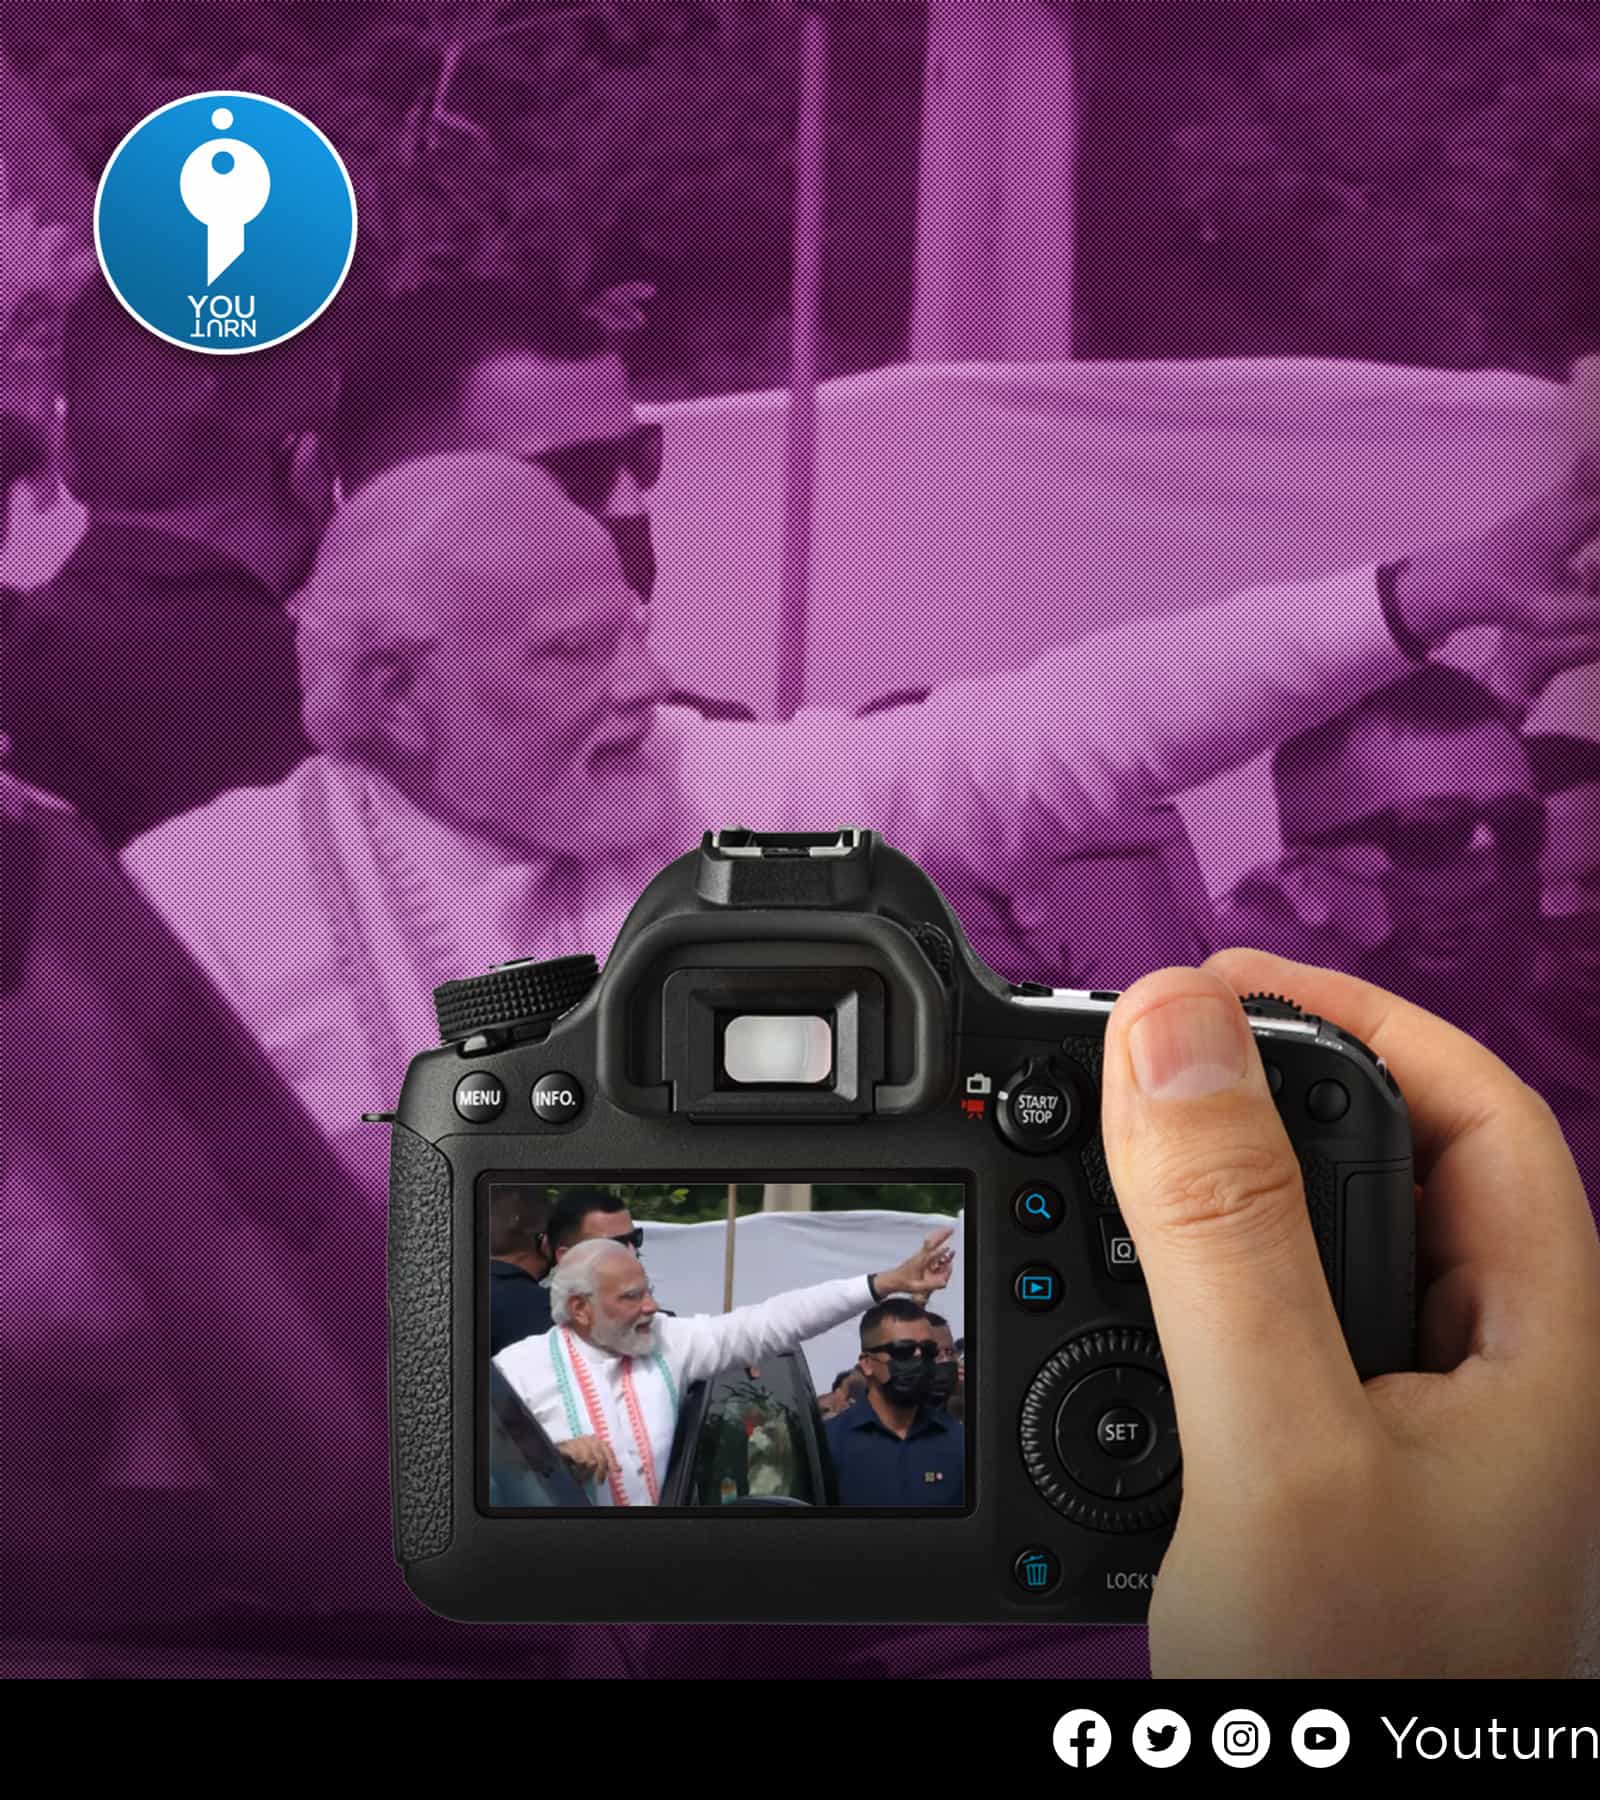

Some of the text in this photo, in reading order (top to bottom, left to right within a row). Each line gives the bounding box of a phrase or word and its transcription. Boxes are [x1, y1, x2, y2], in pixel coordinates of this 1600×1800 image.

[459, 1090, 501, 1106] MENU
[535, 1090, 577, 1106] INFO.
[1022, 1109, 1053, 1124] STOP
[1104, 1423, 1139, 1441] SET
[1106, 1572, 1149, 1590] LOCK
